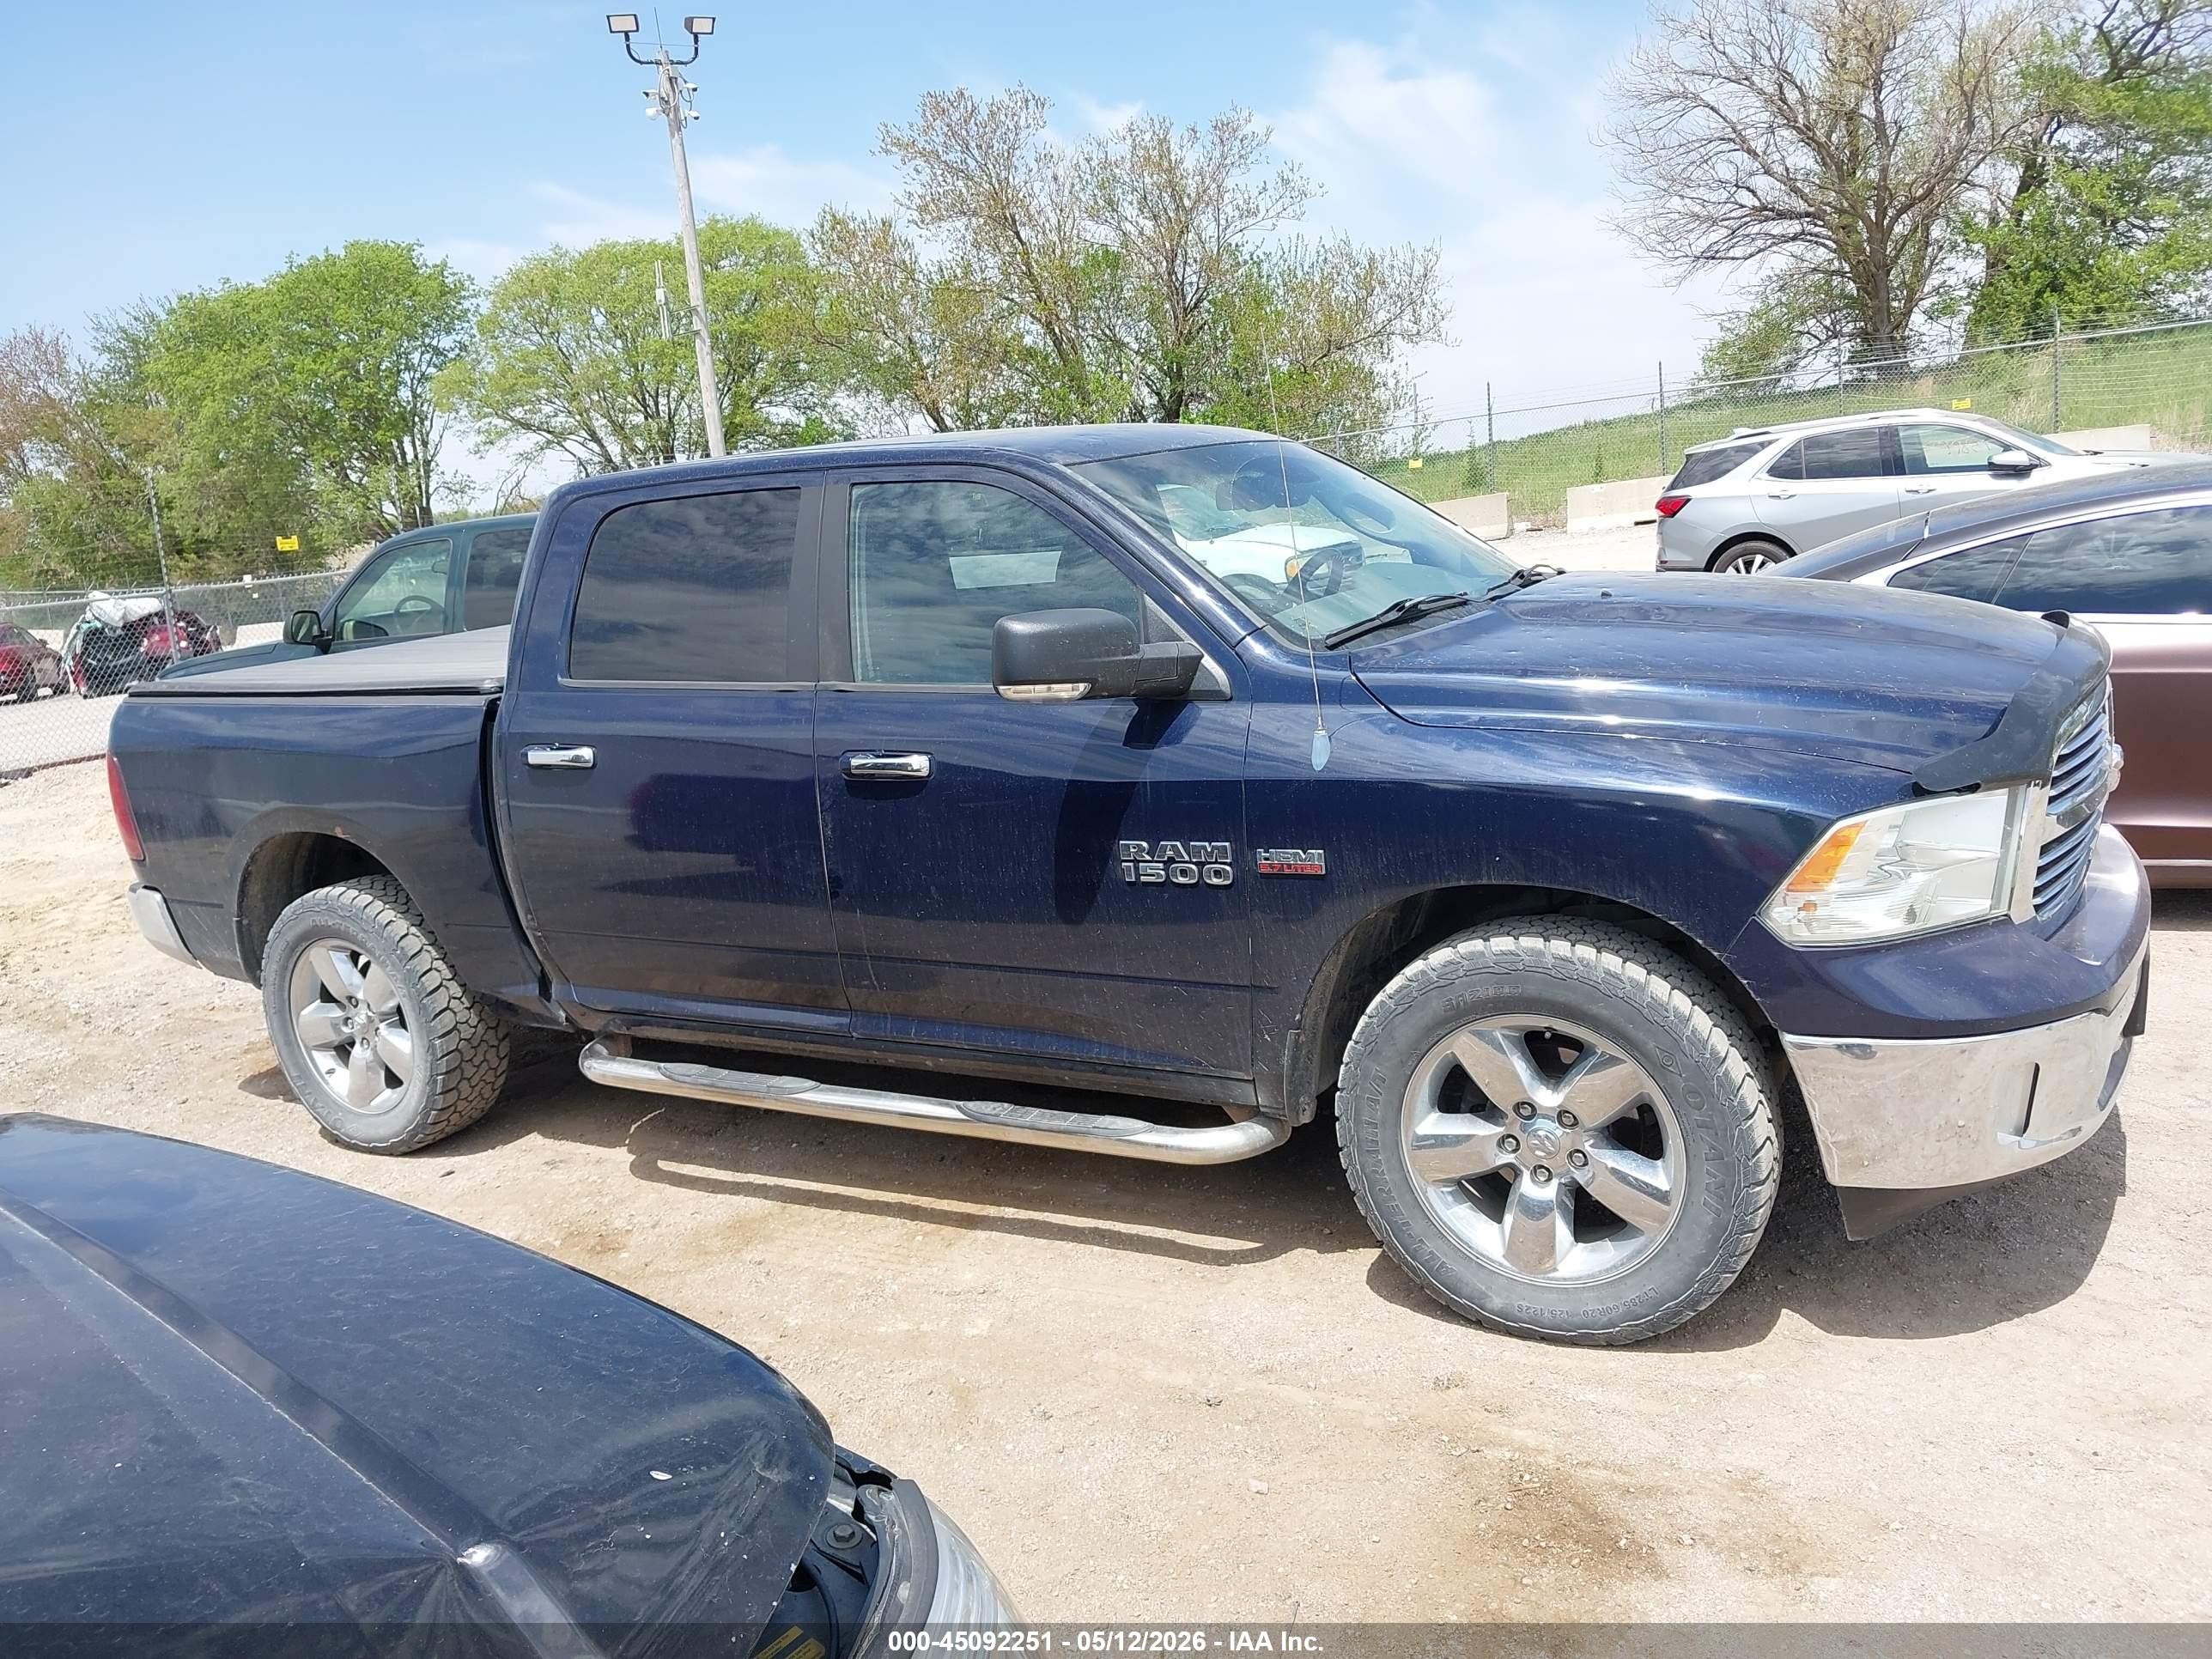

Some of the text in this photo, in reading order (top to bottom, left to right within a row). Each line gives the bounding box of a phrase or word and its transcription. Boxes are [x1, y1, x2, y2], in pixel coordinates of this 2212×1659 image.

[1119, 841, 1232, 862] RAM
[1256, 848, 1325, 863] HEMI
[1121, 862, 1234, 884] 1500
[1260, 863, 1322, 874] 5.7 LITER
[1680, 1081, 1727, 1218] OTANI
